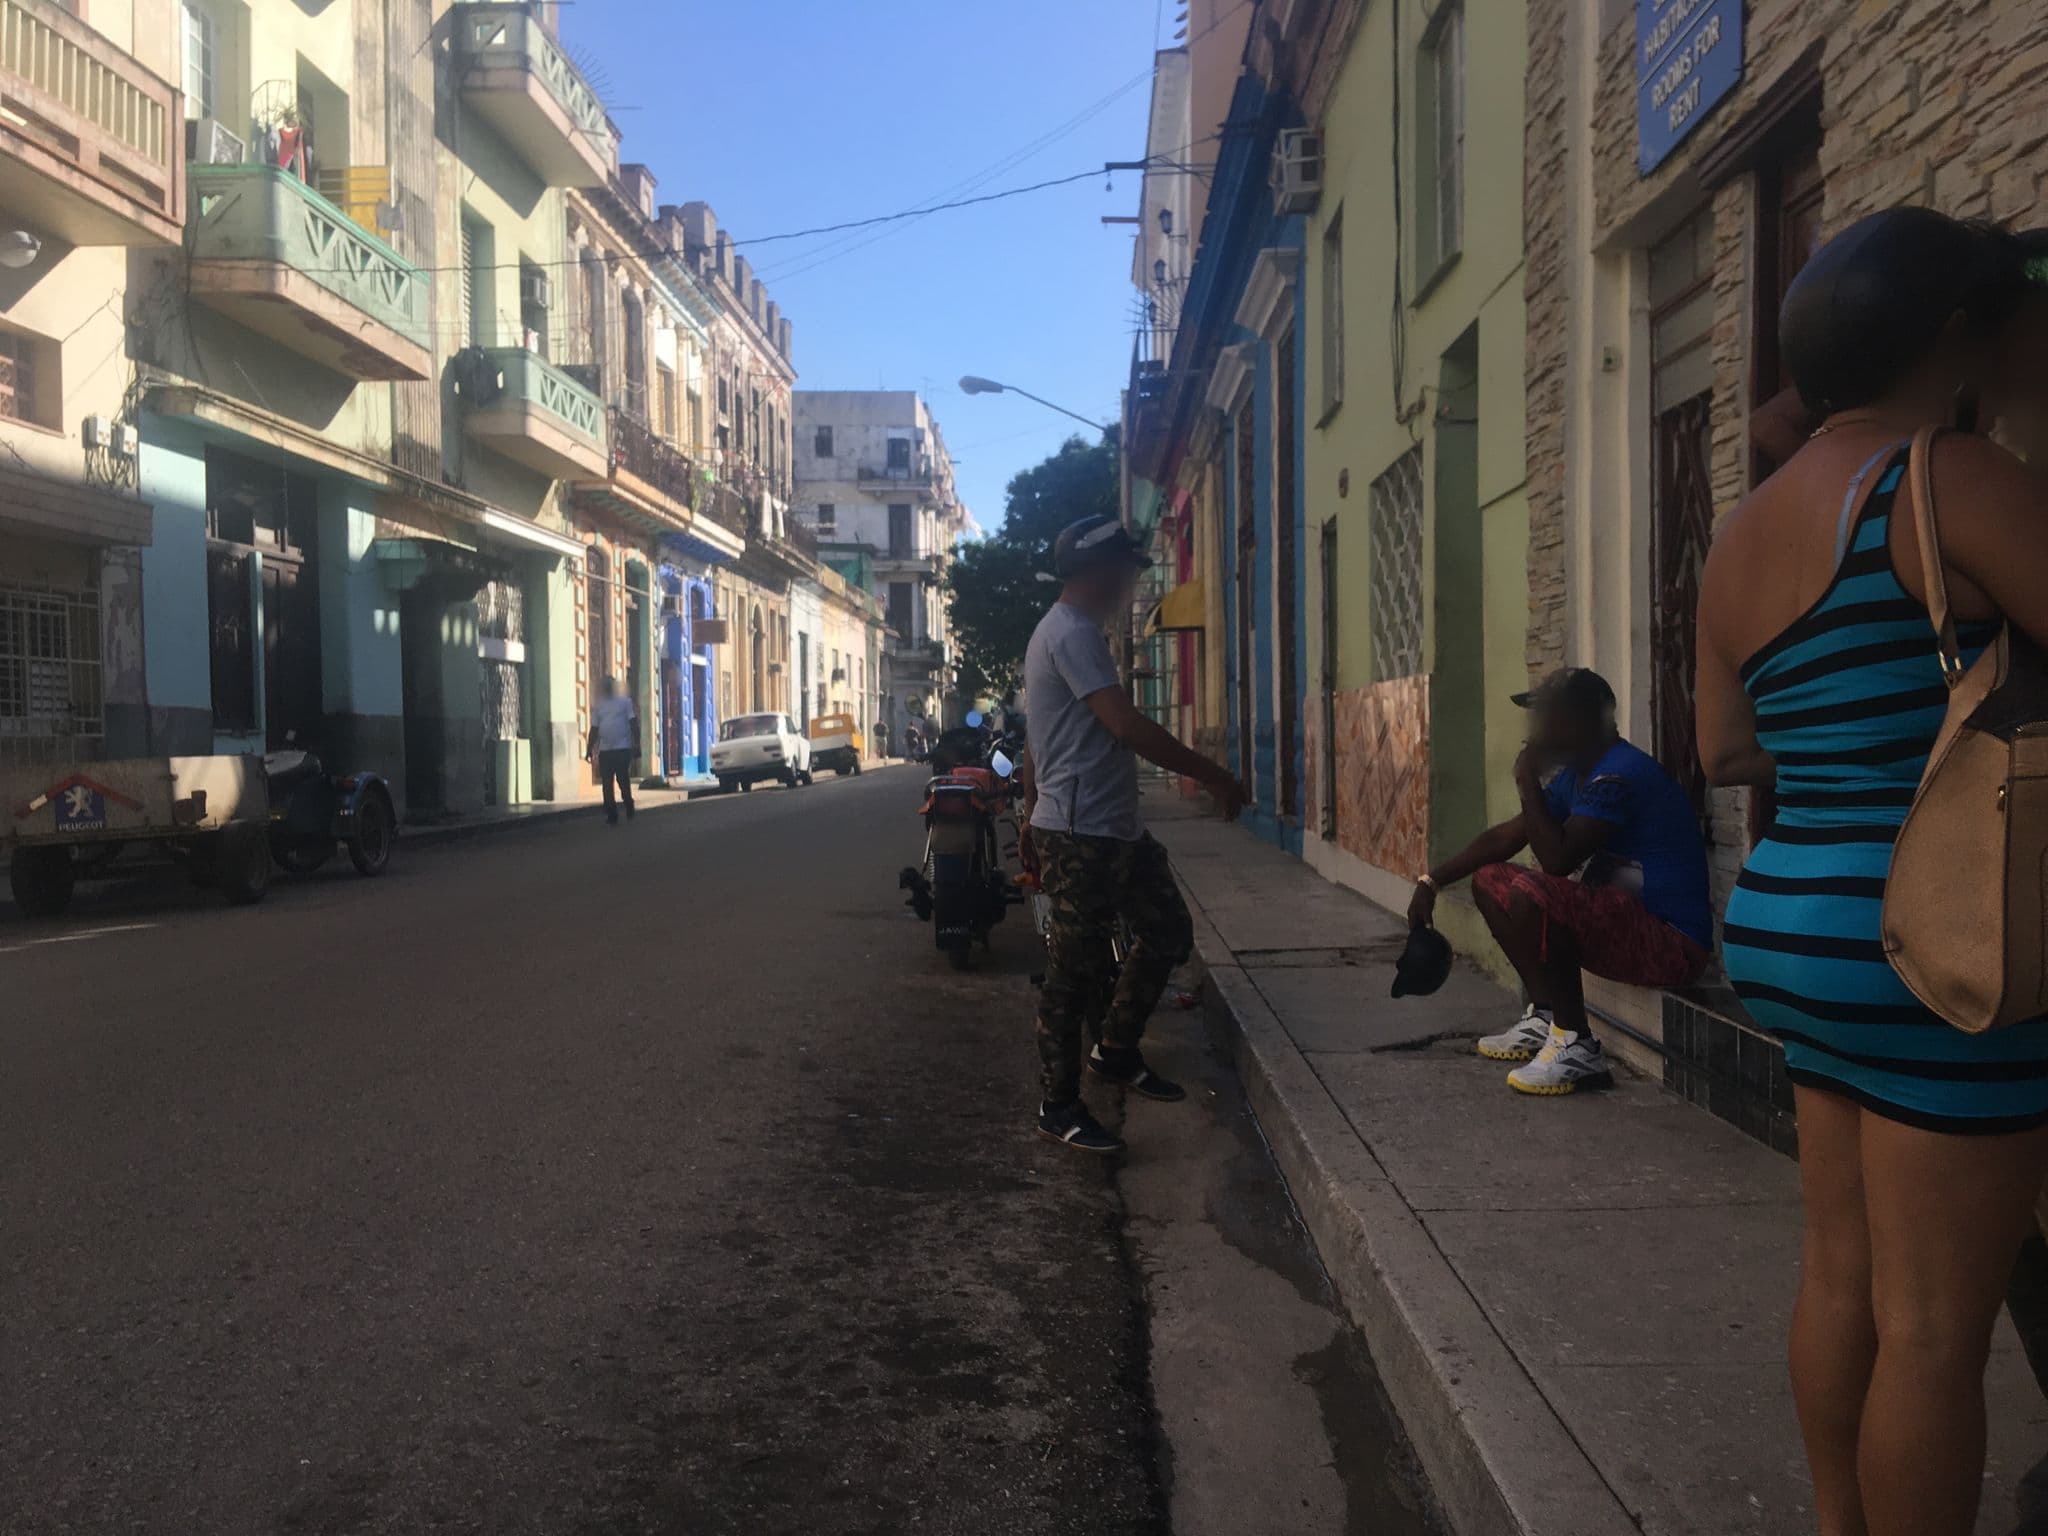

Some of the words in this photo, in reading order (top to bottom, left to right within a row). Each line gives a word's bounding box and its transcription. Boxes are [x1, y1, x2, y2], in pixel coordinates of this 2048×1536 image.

[1652, 46, 1692, 111] ROOMS
[1693, 15, 1720, 63] FOR
[1668, 76, 1700, 131] RENT
[58, 820, 103, 832] PEUGEOT
